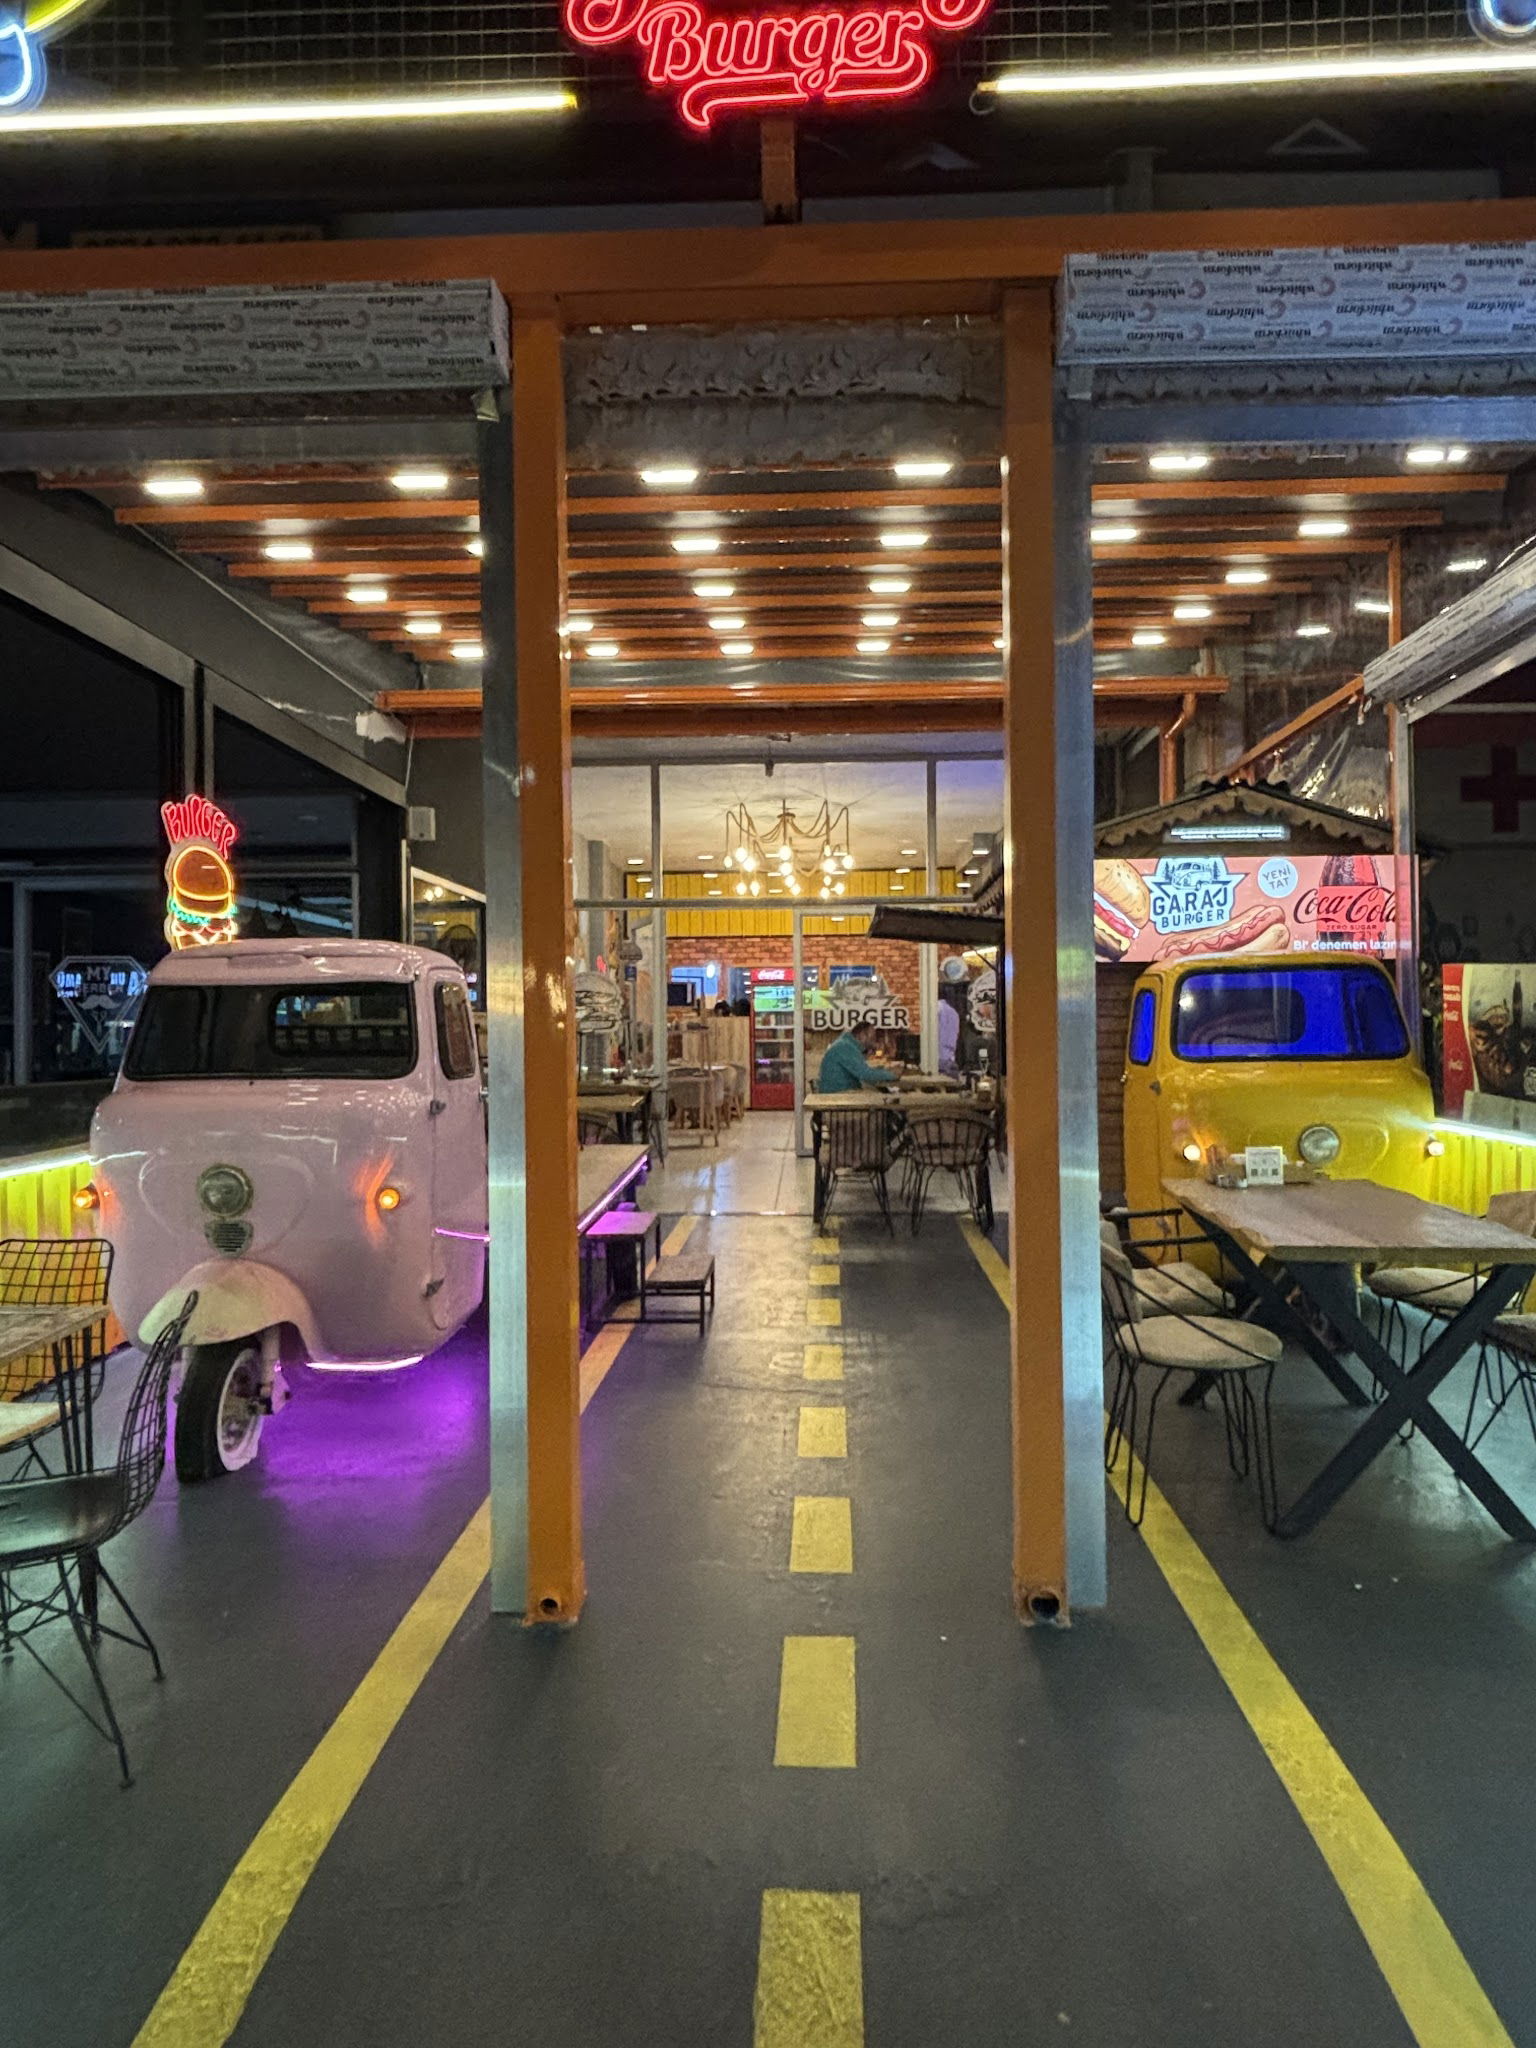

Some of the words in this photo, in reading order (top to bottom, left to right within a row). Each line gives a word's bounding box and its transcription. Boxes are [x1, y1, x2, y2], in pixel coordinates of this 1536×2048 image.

[638, 0, 925, 98] Burger
[164, 794, 236, 860] BURGER
[1269, 877, 1289, 889] TAT
[1153, 887, 1228, 916] GARAJ
[1293, 886, 1396, 924] Coca-Cola
[1161, 909, 1225, 928] BURGER
[1311, 940, 1367, 950] denemen
[814, 1008, 909, 1028] BURGER
